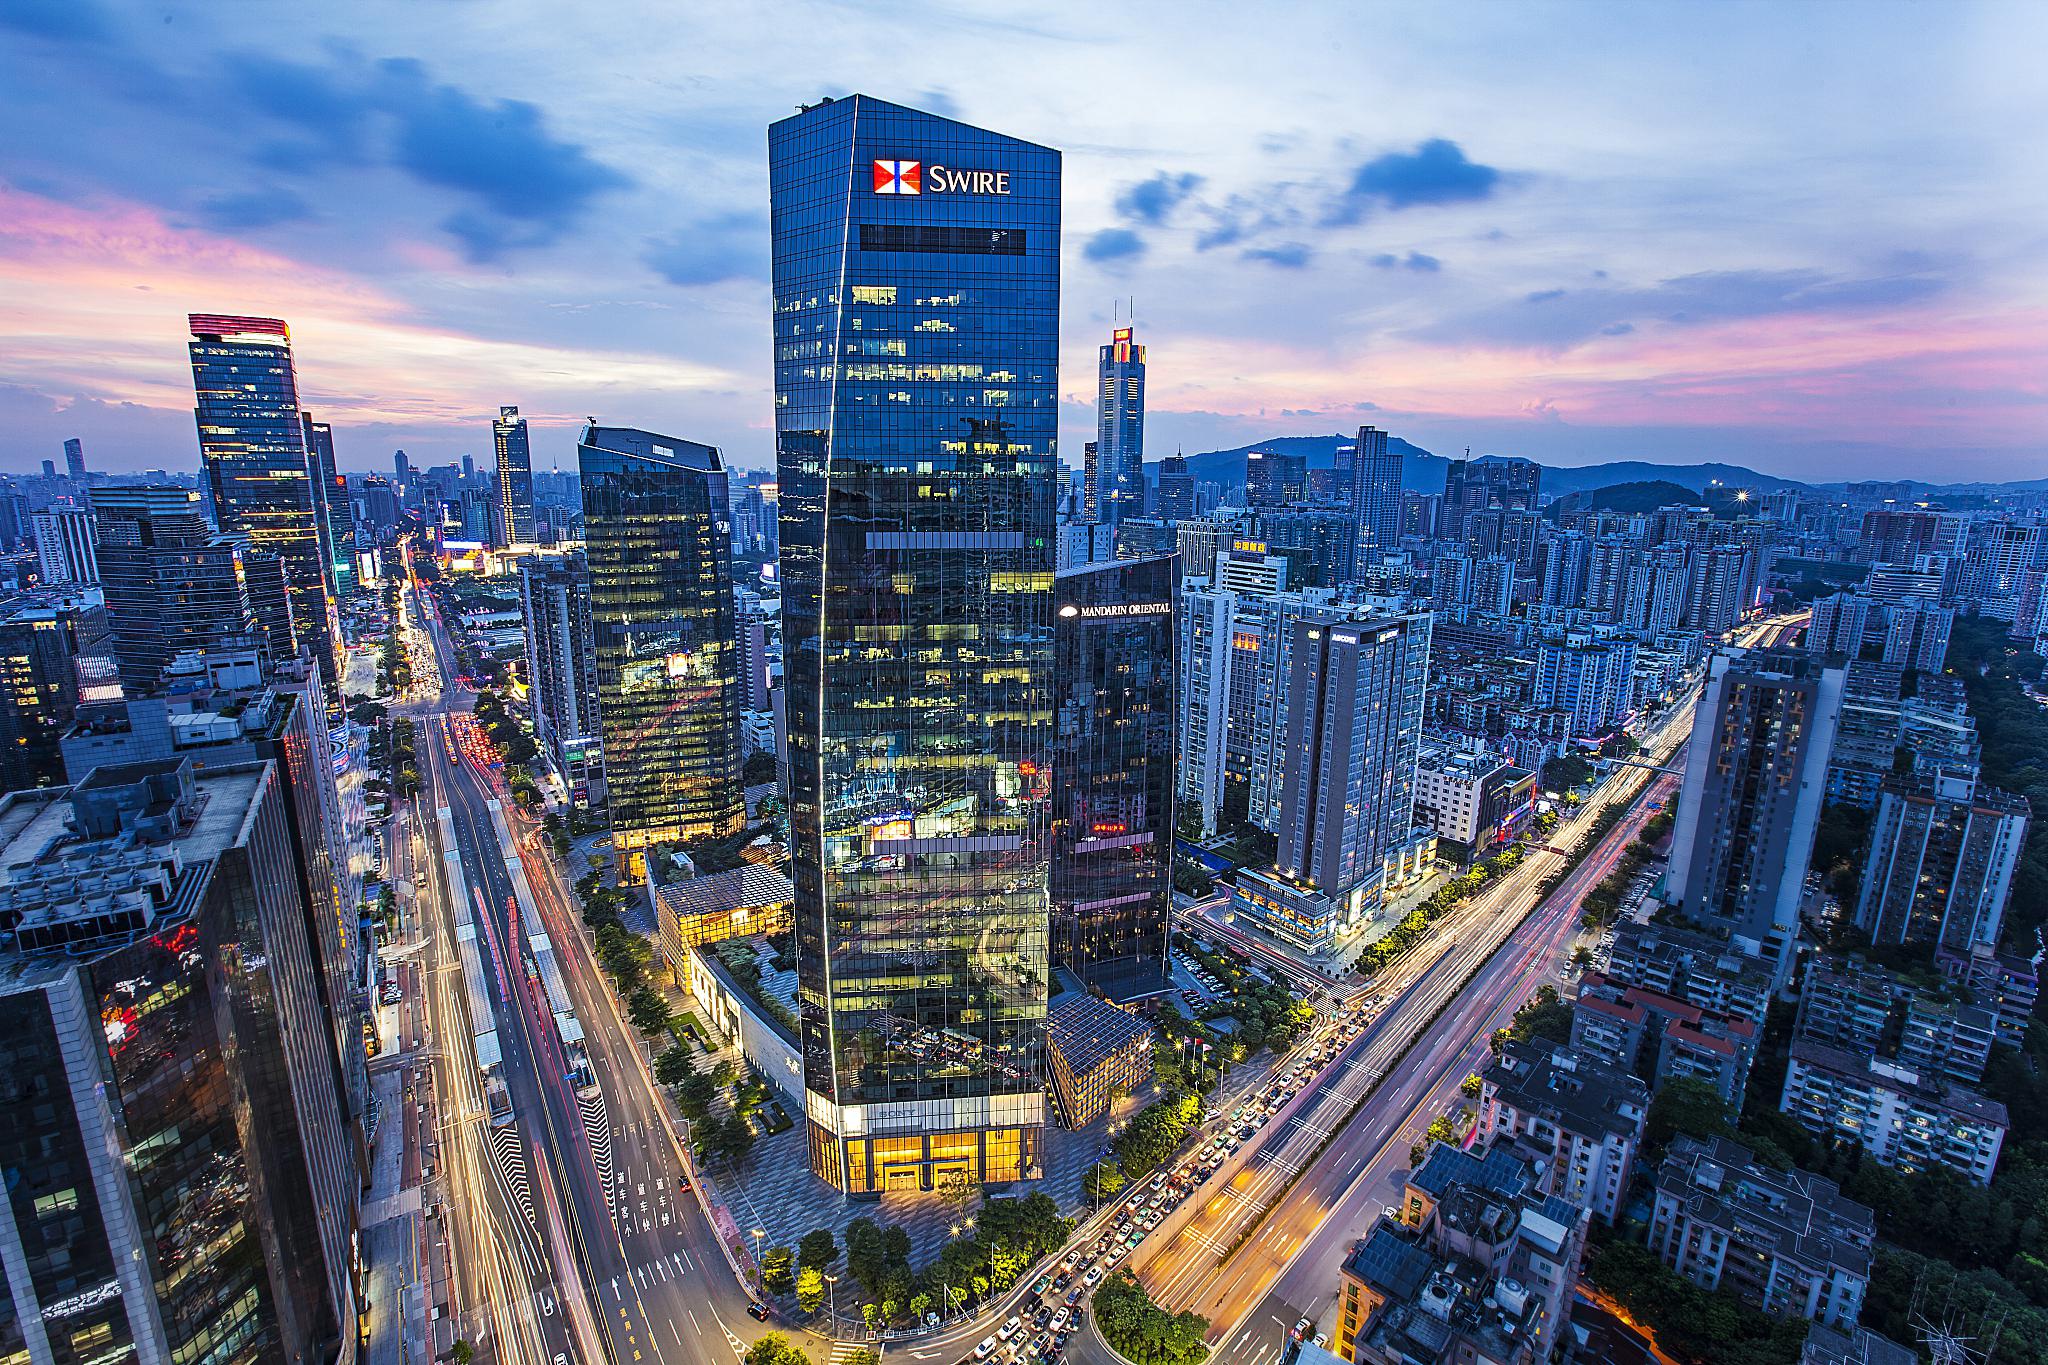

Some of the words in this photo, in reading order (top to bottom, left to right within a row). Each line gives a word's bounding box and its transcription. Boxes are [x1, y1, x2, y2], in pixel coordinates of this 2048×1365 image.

[929, 165, 1011, 195] SWIRE
[1081, 605, 1127, 617] MANDARIN
[1128, 603, 1170, 615] ORIENTAL
[879, 1109, 916, 1118] SONY
